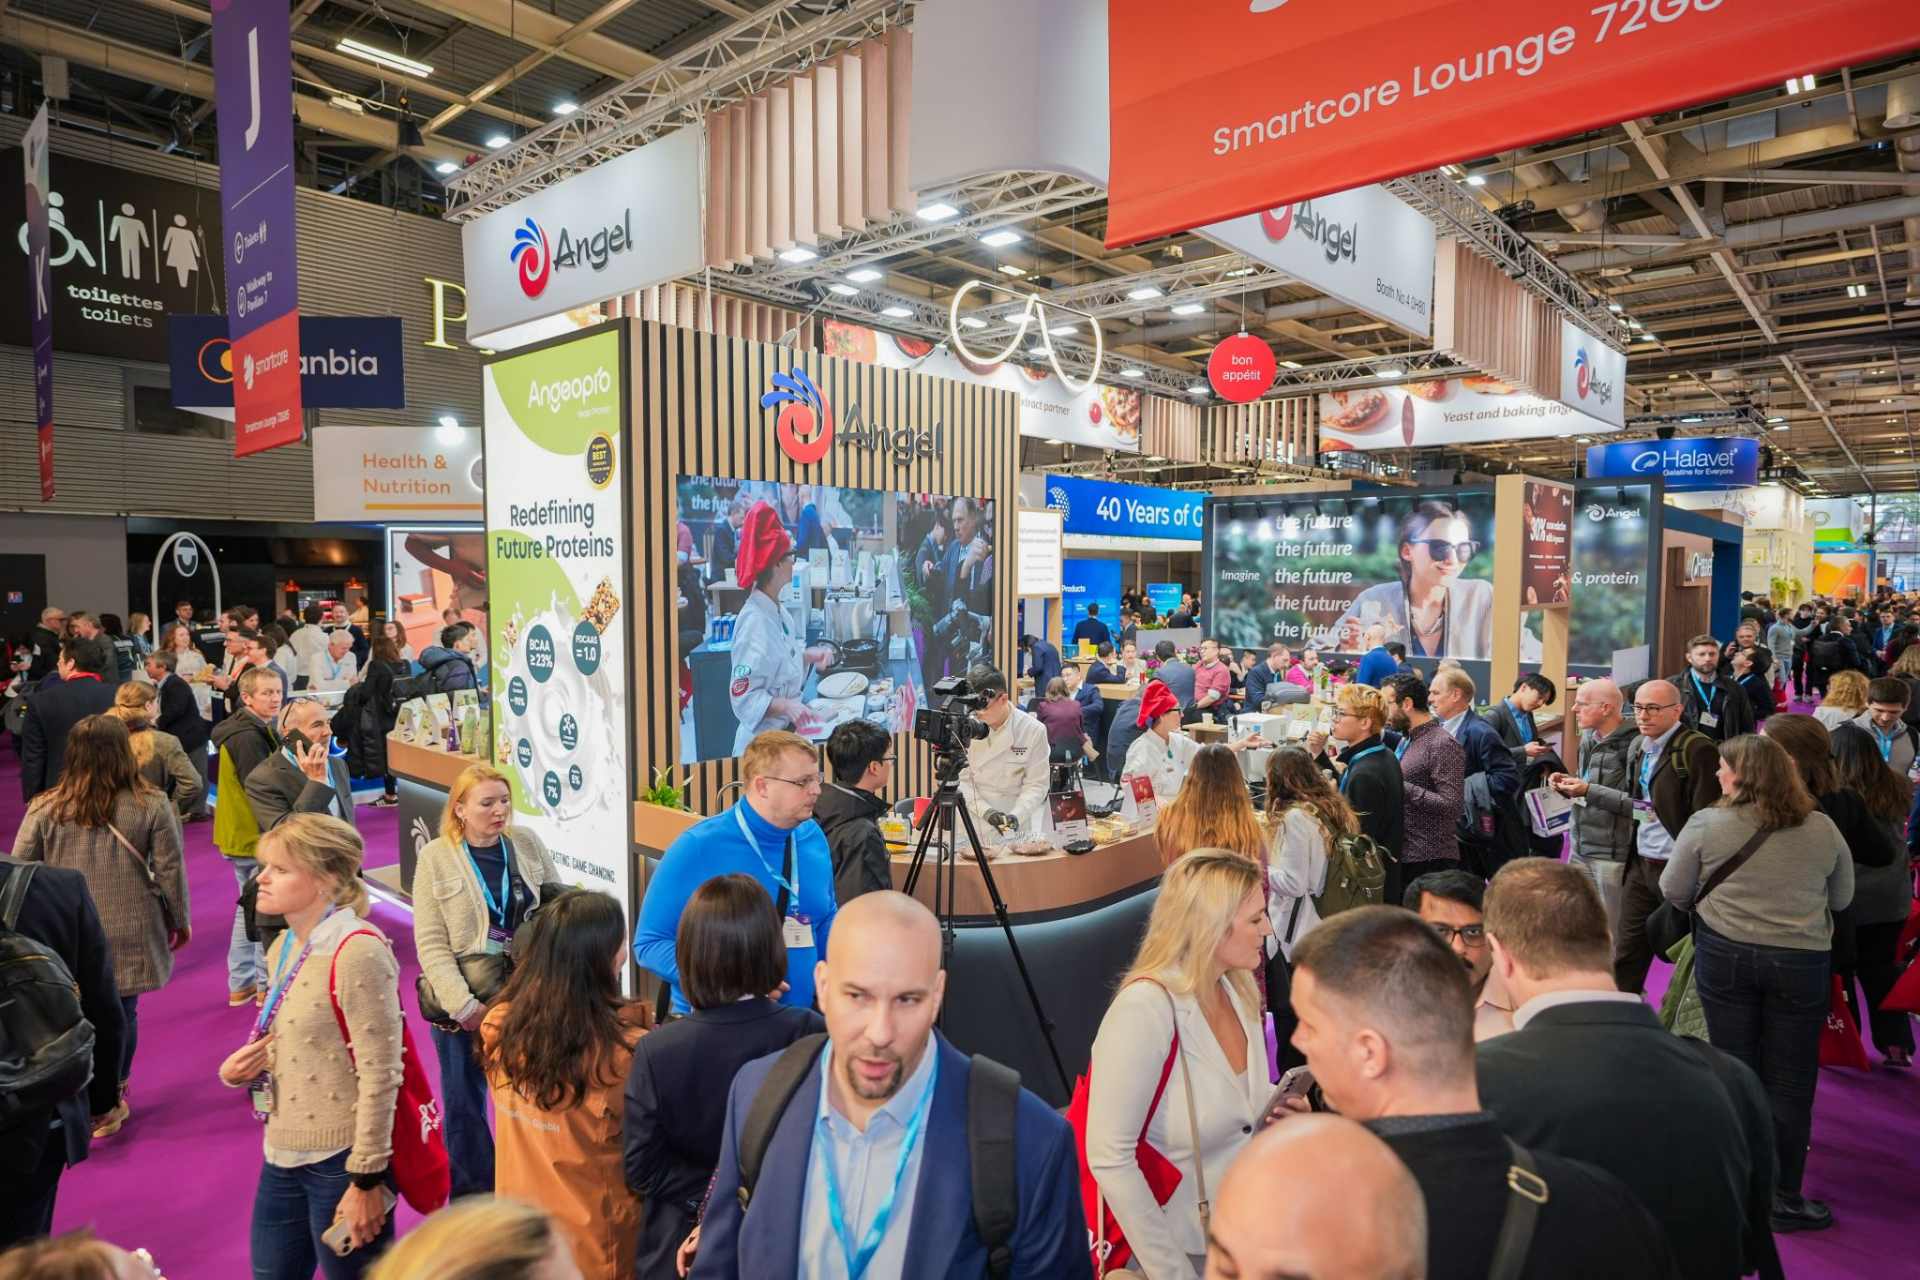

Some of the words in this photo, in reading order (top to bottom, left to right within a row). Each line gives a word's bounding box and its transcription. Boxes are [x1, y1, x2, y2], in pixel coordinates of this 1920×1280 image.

[245, 26, 259, 151] J
[1213, 80, 1400, 156] Smartcore
[1413, 24, 1576, 97] Lounge
[553, 207, 632, 270] Angel
[1294, 200, 1357, 263] Angel
[35, 246, 48, 321] K
[67, 284, 163, 311] toilettes
[81, 306, 153, 328] toilets
[255, 349, 289, 376] smartcore
[1231, 354, 1253, 366] bon
[1222, 368, 1261, 383] appétit
[528, 365, 611, 414] Angeopro
[1443, 409, 1474, 424] Yeast
[1476, 409, 1500, 421] and
[1503, 404, 1545, 419] baking
[835, 400, 944, 466] Angel
[362, 453, 428, 470] Health
[433, 454, 447, 470] &
[363, 478, 451, 495] Nutrition
[692, 494, 710, 511] the
[1096, 496, 1121, 522] 40
[1125, 498, 1170, 526] Years
[1174, 502, 1190, 526] of
[510, 498, 595, 529] Redefining
[1276, 514, 1301, 530] the
[1303, 513, 1353, 531] future
[1606, 507, 1641, 520] Angel
[496, 536, 543, 560] Future
[546, 531, 615, 558] Proteins
[1275, 542, 1300, 557] the
[1303, 541, 1353, 558] future
[1221, 569, 1261, 583] Imagine
[1275, 569, 1300, 585] the
[1302, 568, 1353, 586] future
[1571, 571, 1582, 585] &
[1585, 571, 1639, 586] protein
[1275, 594, 1300, 611] the
[1302, 594, 1352, 612] future
[1274, 621, 1300, 638] the
[529, 638, 551, 652] BCAA
